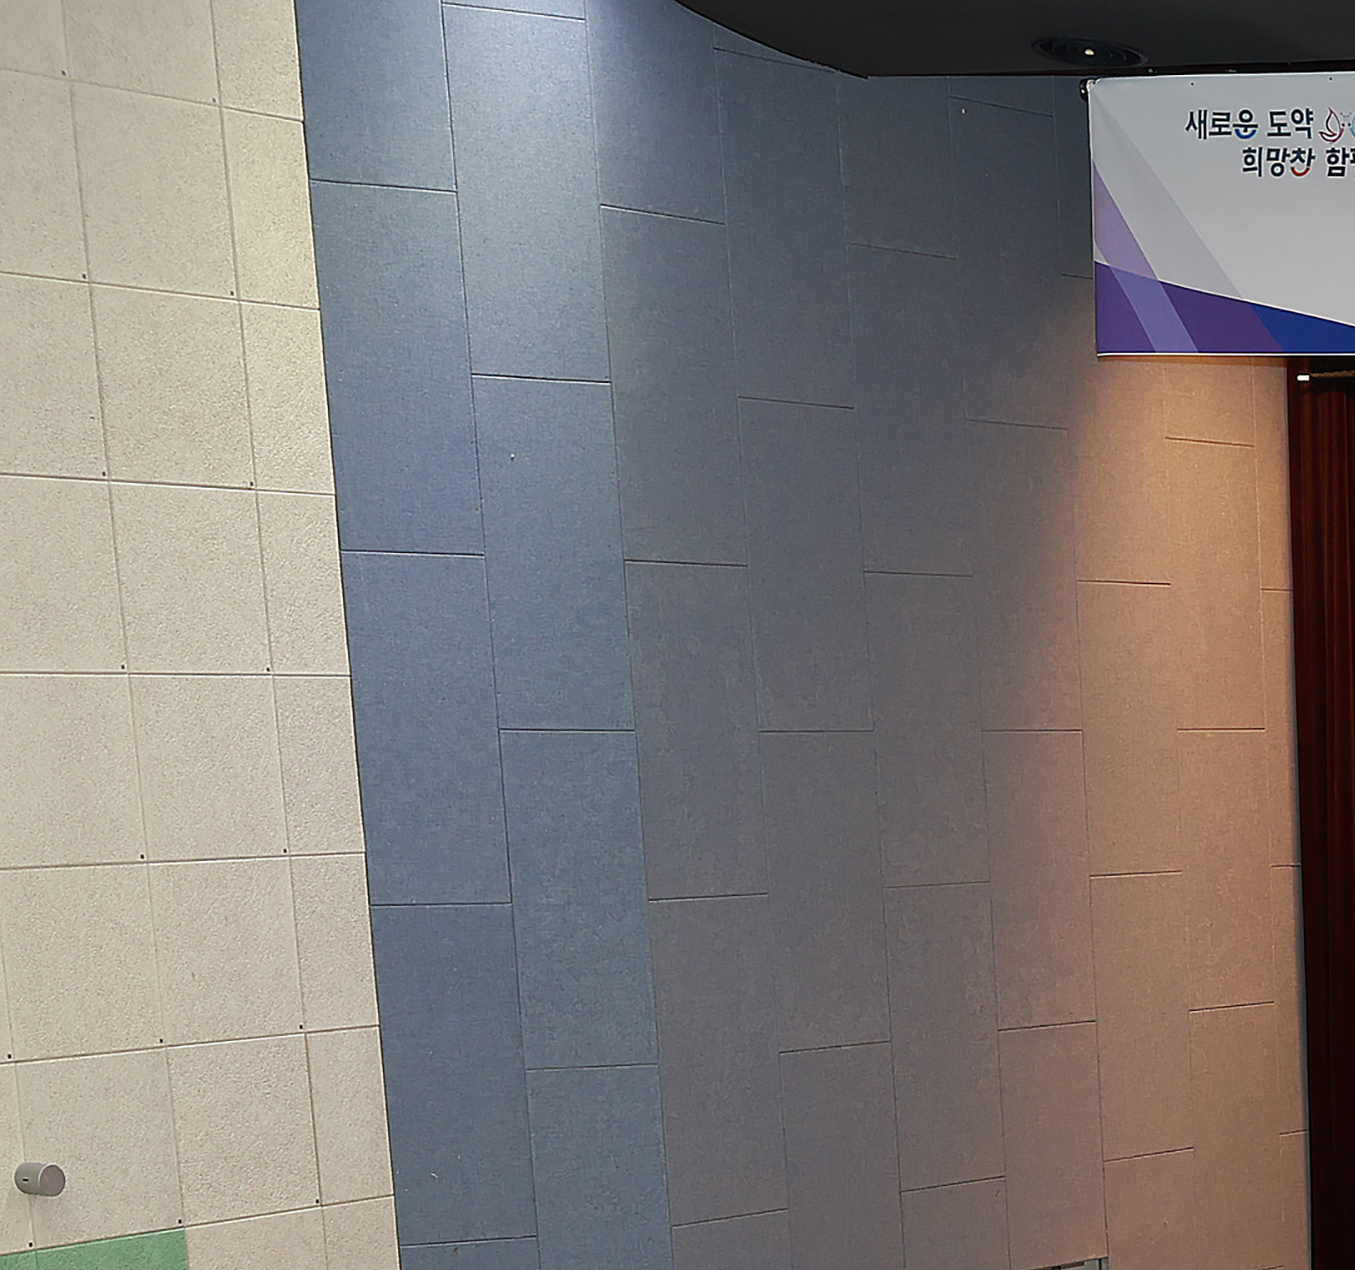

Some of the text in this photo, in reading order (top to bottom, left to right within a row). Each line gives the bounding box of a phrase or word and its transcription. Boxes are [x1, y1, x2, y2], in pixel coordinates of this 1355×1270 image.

[1184, 107, 1315, 141] 새로운 도약
[1241, 146, 1316, 178] 희망찬
